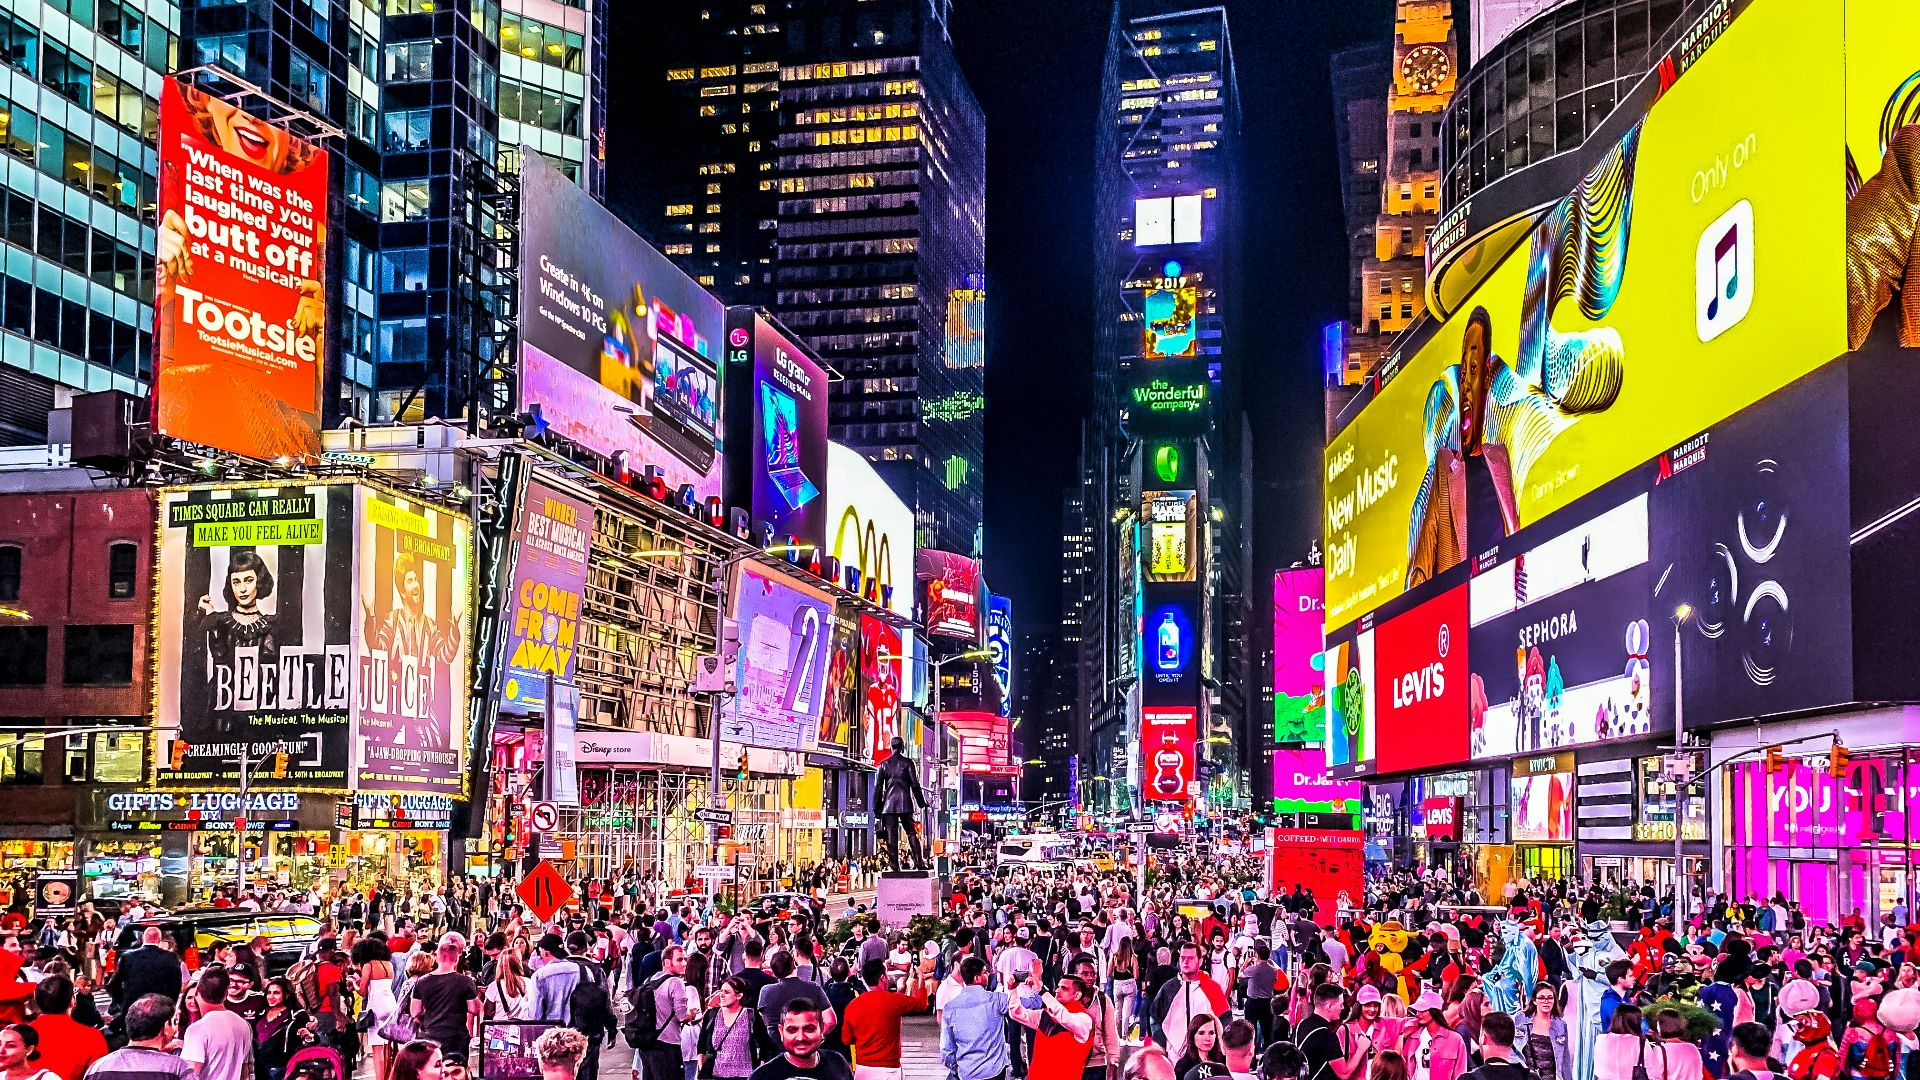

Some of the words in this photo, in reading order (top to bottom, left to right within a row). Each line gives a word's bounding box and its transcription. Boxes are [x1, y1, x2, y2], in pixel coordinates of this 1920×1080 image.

[1682, 0, 1735, 55] MARRIOT
[1681, 15, 1730, 73] MARQUIS
[1691, 154, 1730, 203] Only
[1733, 133, 1756, 168] on
[186, 163, 223, 194] last
[230, 183, 274, 214] time
[280, 206, 313, 231] you
[248, 174, 282, 199] was
[286, 189, 313, 212] the
[185, 184, 267, 231] laughed
[271, 221, 312, 248] your
[1432, 202, 1472, 248] MARRIOTT
[184, 204, 260, 259] butt
[265, 243, 312, 277] off
[191, 242, 209, 258] at
[214, 250, 224, 264] a
[1432, 224, 1465, 265] MARQUIS
[540, 255, 569, 287] Create
[570, 274, 579, 293] in
[581, 283, 591, 302] 4K
[592, 295, 604, 310] on
[1155, 276, 1187, 290] 2019
[540, 277, 580, 316] Windows
[581, 306, 591, 323] 10
[592, 312, 607, 334] PCs
[175, 284, 316, 362] Tootsie
[197, 329, 298, 369] TootsieMusical.com
[731, 350, 748, 362] LG
[776, 347, 787, 369] LG
[1134, 384, 1204, 402] Wonderful
[1152, 379, 1169, 390] the
[1673, 432, 1710, 459] MARRIOTT
[1673, 448, 1705, 472] MARQUIS
[173, 504, 203, 521] TIMES
[206, 502, 246, 521] SQUARE
[249, 500, 268, 516] CAN
[272, 498, 311, 515] REALLY
[1327, 490, 1355, 538] New
[1357, 450, 1399, 515] Music
[545, 496, 578, 527] WINNER!
[198, 527, 228, 542] MAKE
[233, 526, 252, 541] YOU
[257, 525, 282, 540] FEEL
[286, 523, 320, 539] ALIVE!
[526, 534, 535, 546] ALL
[528, 511, 550, 539] BEST
[551, 521, 586, 552] MUSICAL
[403, 535, 413, 550] ON
[415, 538, 450, 561] BROADWAY!
[1328, 530, 1358, 582] Daily
[519, 579, 579, 620] COME
[514, 607, 576, 647] FROM
[1519, 610, 1577, 649] SEPHORA
[510, 639, 572, 678] AWAY
[214, 653, 347, 710] BEETLE
[359, 652, 431, 719] JUICE
[973, 662, 982, 694] 1500
[248, 715, 262, 726] The
[301, 714, 316, 725] The
[252, 741, 279, 755] GOOD
[579, 740, 612, 757] Disney
[613, 746, 631, 754] store
[1530, 757, 1556, 772] INVICTA
[108, 793, 173, 811] GIFTS
[190, 793, 299, 811] LUGGAGE
[354, 793, 391, 809] GIFTS
[400, 795, 453, 810] LUGGAGE
[1377, 793, 1391, 817] BIG
[1772, 786, 1831, 813] YOU
[168, 821, 199, 830] Canon
[246, 822, 265, 830] OWER
[1278, 834, 1316, 843] COFFEED
